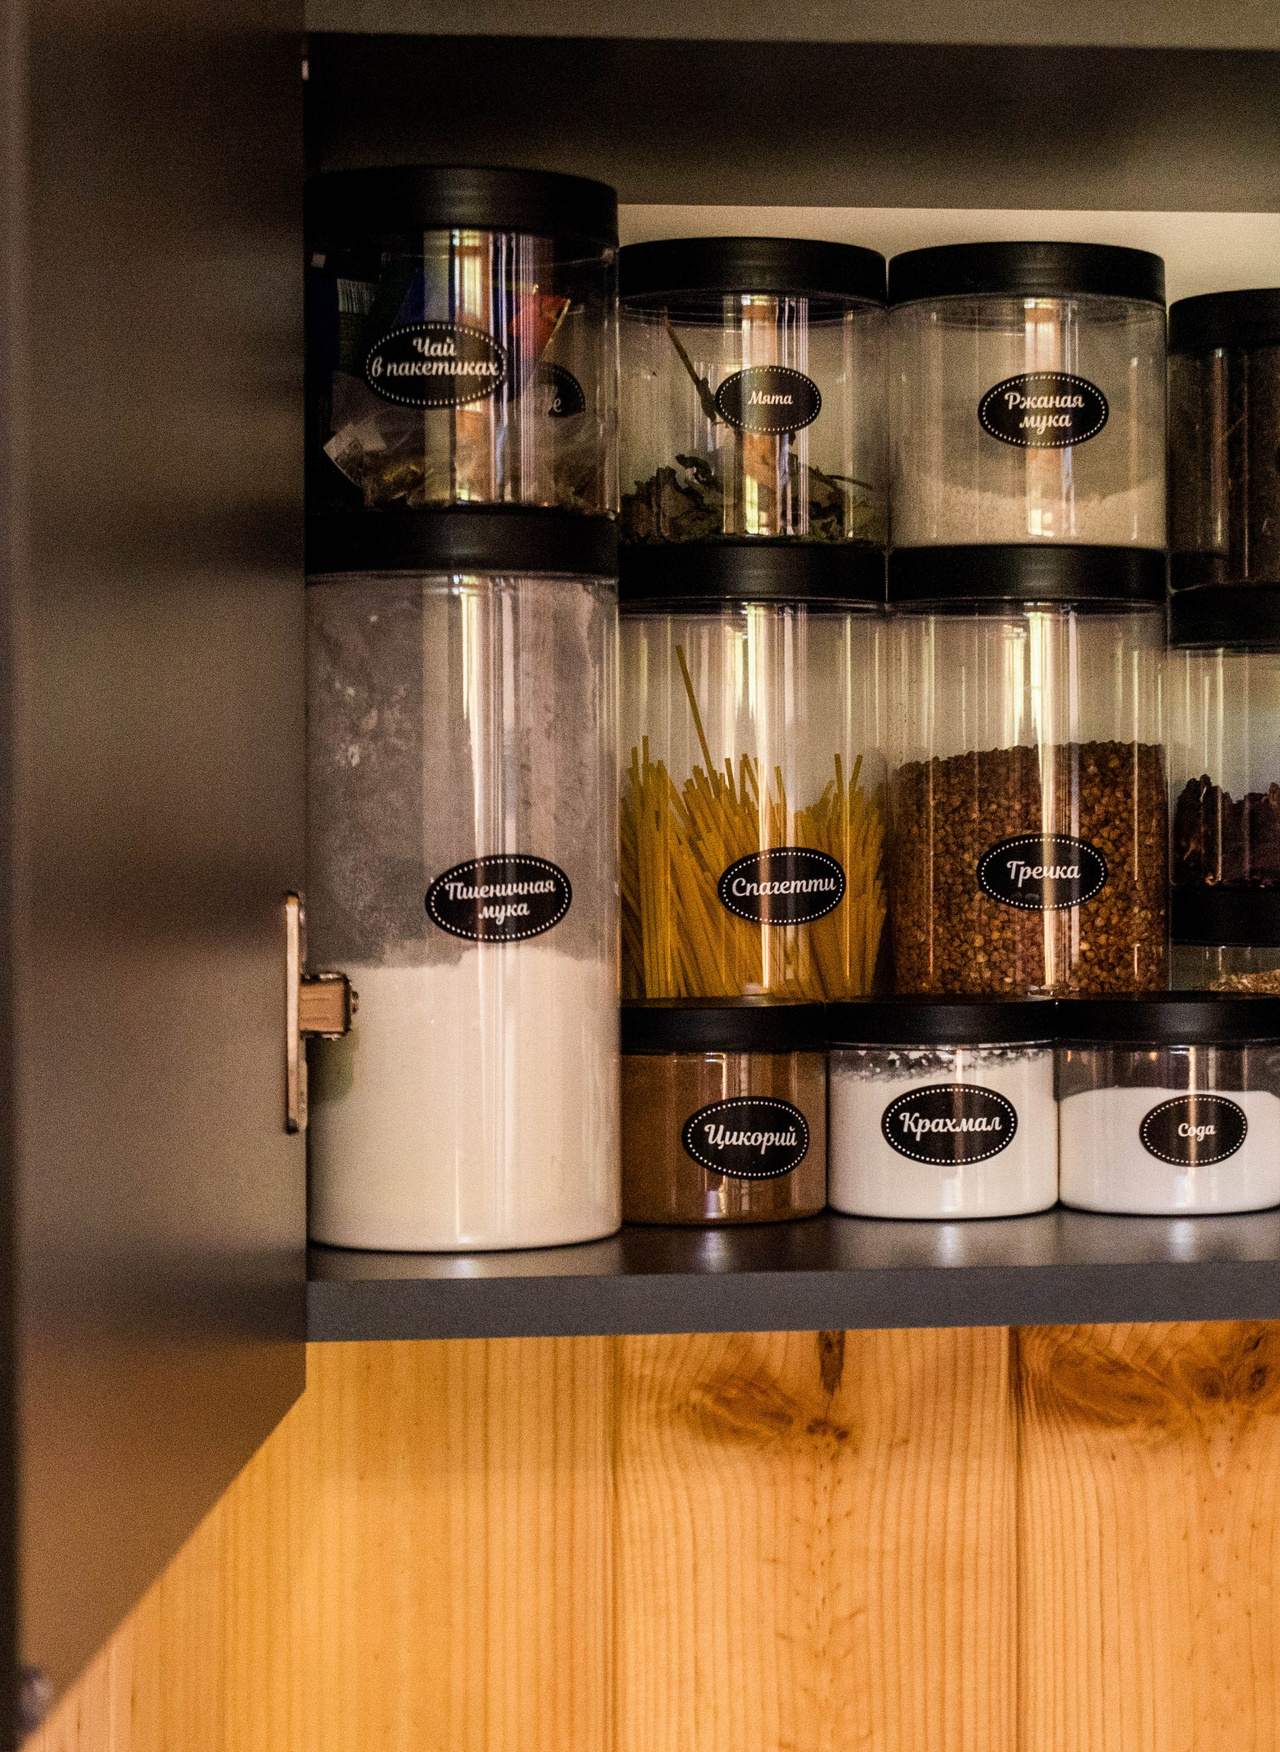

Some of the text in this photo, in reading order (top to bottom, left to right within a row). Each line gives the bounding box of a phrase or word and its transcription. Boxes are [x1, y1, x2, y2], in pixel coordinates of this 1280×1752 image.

[412, 336, 458, 358] Чай
[371, 356, 500, 378] в пакетиках
[747, 390, 794, 406] Мята
[1004, 391, 1085, 410] Ржаная
[1019, 413, 1073, 435] мука
[1006, 860, 1082, 888] Гречка
[444, 879, 557, 901] Пшеничная
[731, 877, 837, 897] Спагетти
[478, 902, 531, 926] мука
[898, 1111, 1003, 1142] Крахмал
[1177, 1122, 1217, 1142] Сода
[703, 1125, 798, 1155] Цикорий
